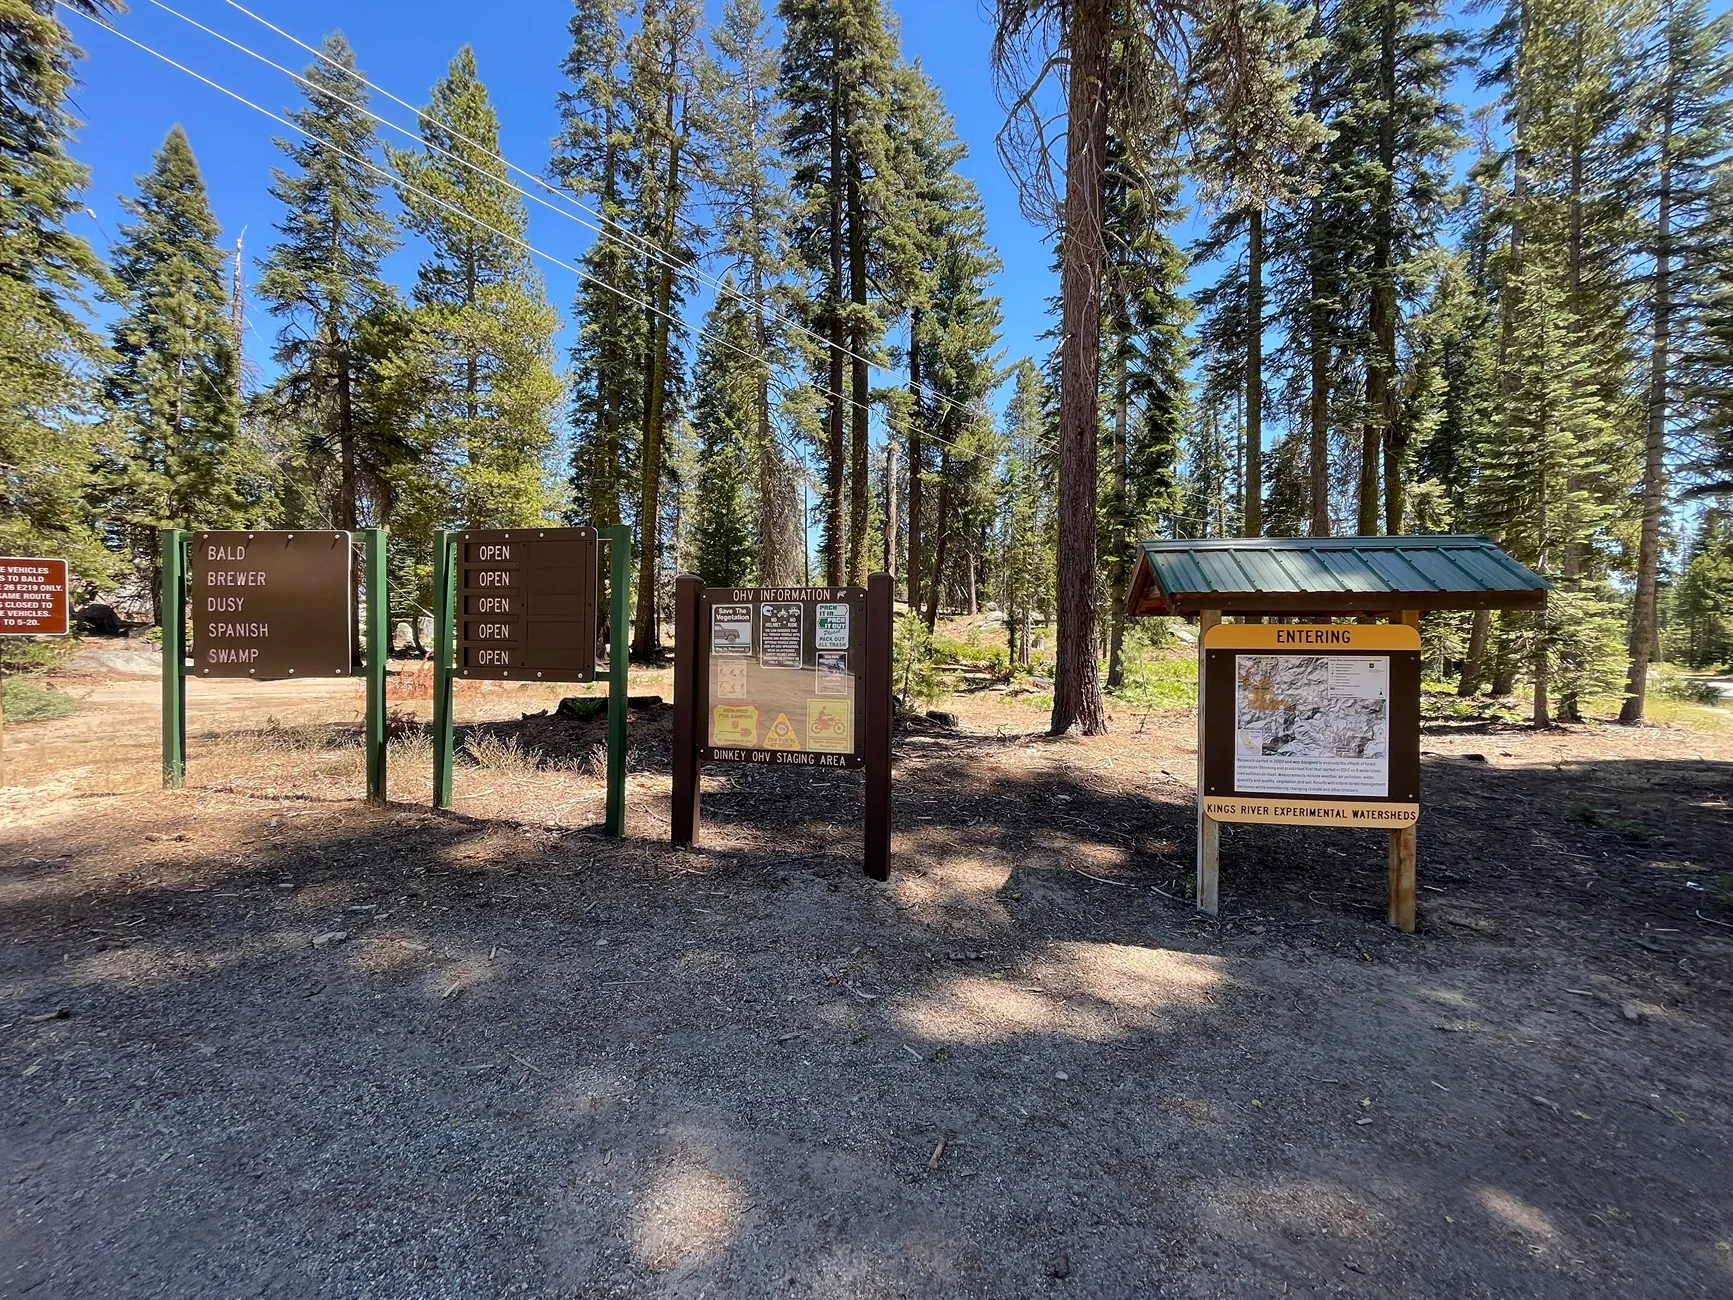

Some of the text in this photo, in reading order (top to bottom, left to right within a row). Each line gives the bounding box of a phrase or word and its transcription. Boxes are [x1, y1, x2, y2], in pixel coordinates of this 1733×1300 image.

[208, 546, 246, 561] BALD
[479, 545, 510, 560] OPEN
[207, 572, 267, 586] BREWER
[479, 571, 510, 586] OPEN
[733, 589, 831, 602] OHV INFORMATION
[207, 598, 245, 612] DUSY
[479, 598, 509, 613] OPEN
[208, 623, 269, 638] SPANISH
[479, 624, 509, 639] OPEN
[1276, 629, 1351, 644] ENTERING
[208, 649, 259, 664] SWAMP
[479, 650, 509, 665] OPEN
[714, 749, 846, 767] DINKEY OHV STAGING AREA
[1207, 803, 1416, 821] KINGS RIVER EXPERIMENTAL WATERSHEDS
